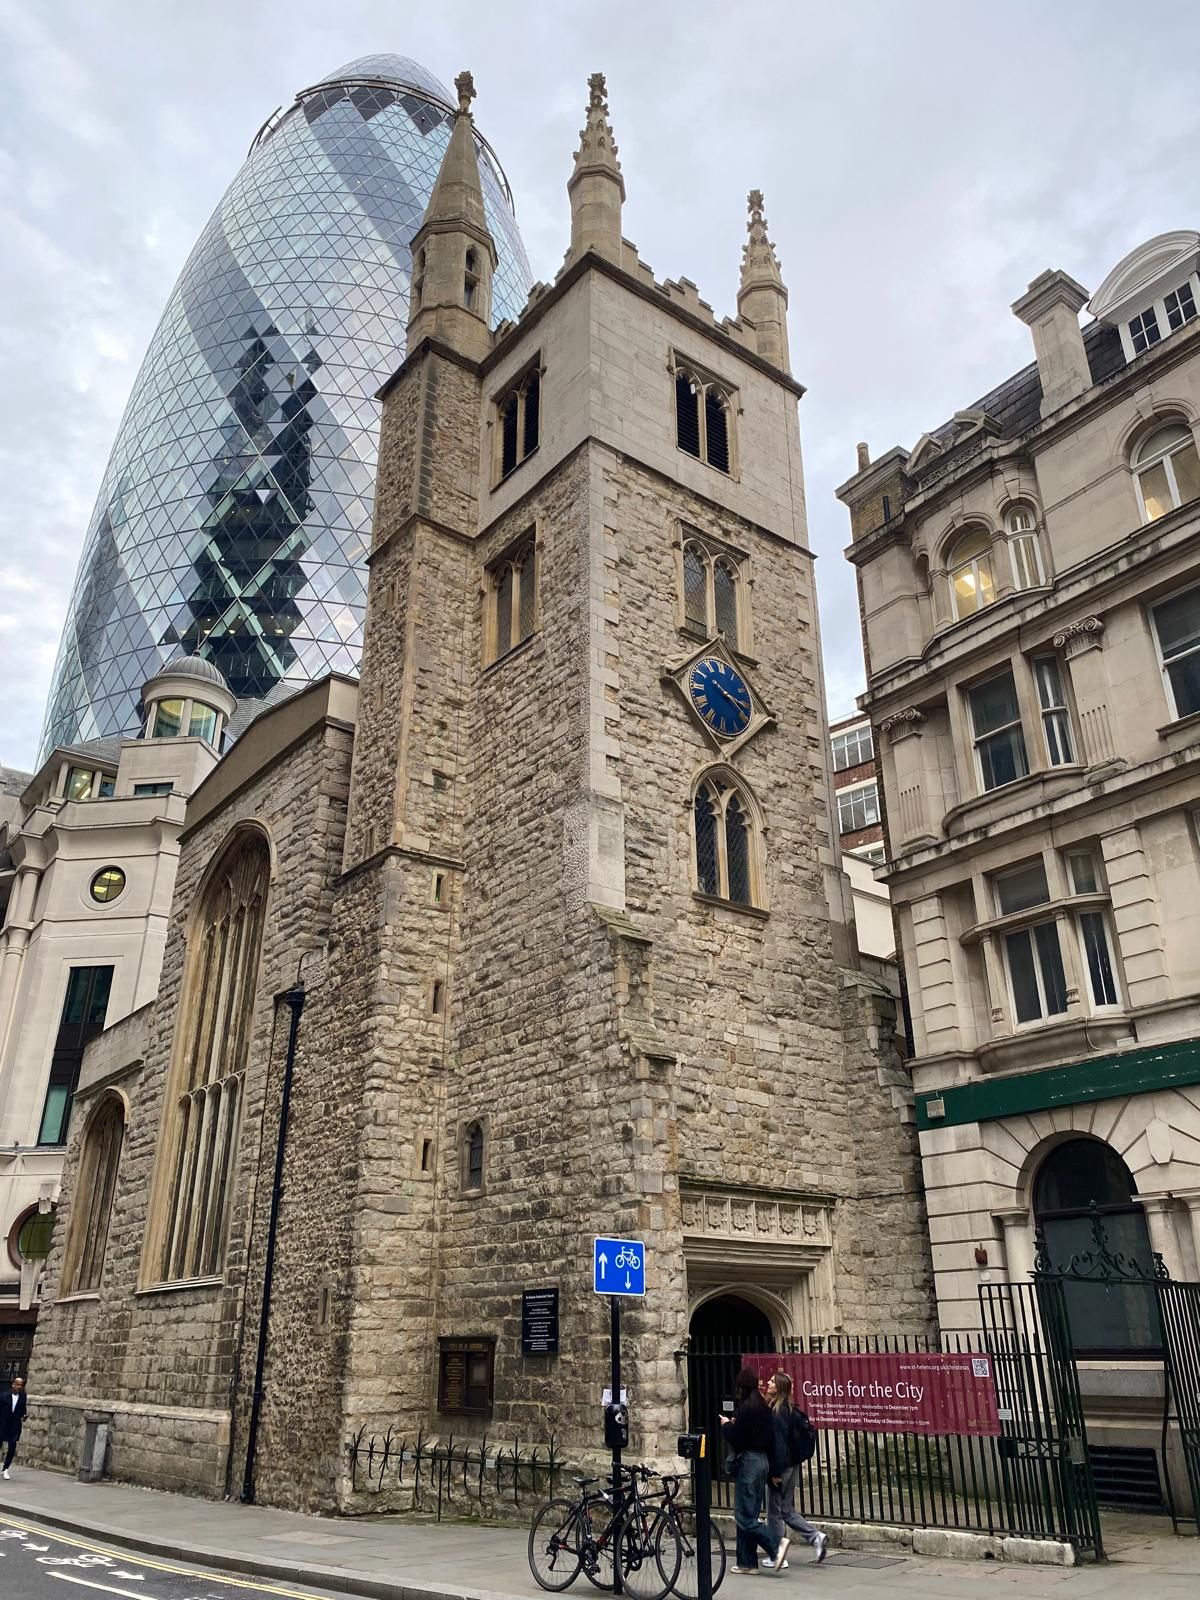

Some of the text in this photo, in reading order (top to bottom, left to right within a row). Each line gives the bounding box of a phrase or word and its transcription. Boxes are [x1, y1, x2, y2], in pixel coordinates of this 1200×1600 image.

[802, 1380, 924, 1402] Carols for the City
